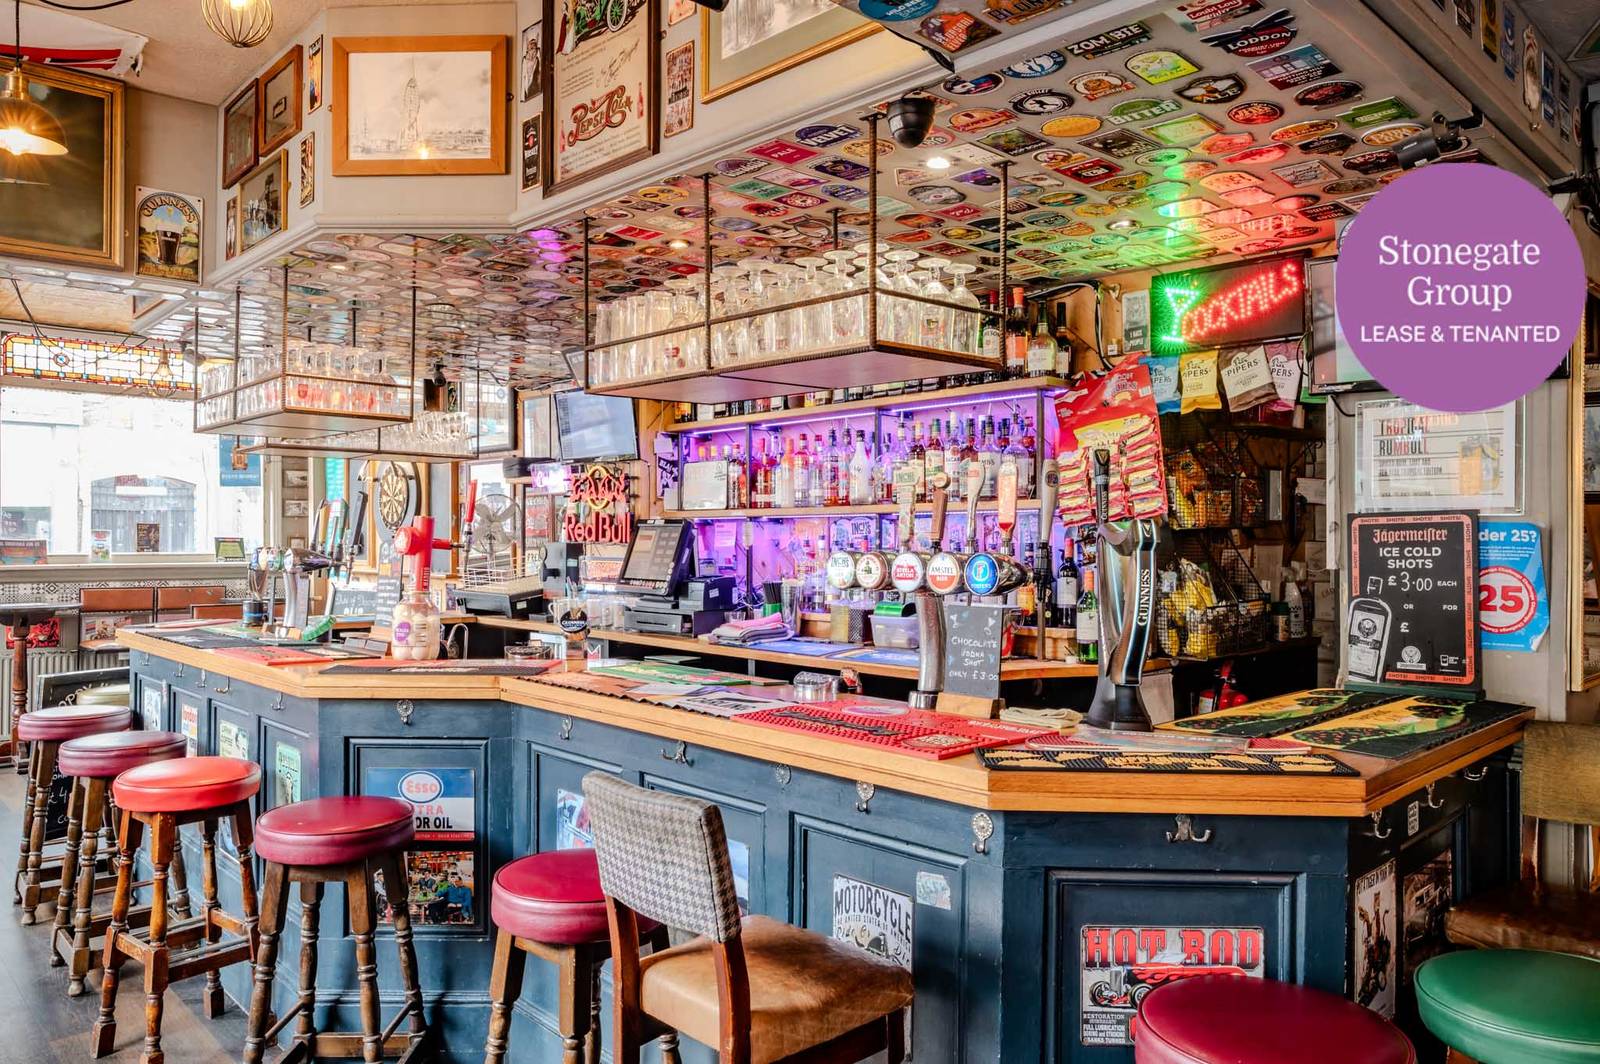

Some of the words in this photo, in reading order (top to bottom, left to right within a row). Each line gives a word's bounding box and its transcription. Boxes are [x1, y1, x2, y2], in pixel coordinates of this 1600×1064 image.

[1228, 31, 1293, 51] LODDON
[1107, 101, 1180, 125] BITTER
[801, 126, 856, 147] VELVET
[771, 147, 797, 159] PALE
[143, 196, 197, 223] GUINNESS
[1181, 262, 1299, 341] COCKTAILS
[1226, 359, 1260, 377] PIPERS
[565, 512, 596, 543] Red
[599, 512, 631, 543] Bull
[1478, 529, 1506, 542] der
[1511, 530, 1537, 543] 25?
[1379, 547, 1400, 557] ICE
[1404, 547, 1442, 557] COLD
[931, 567, 953, 575] AMSTEL
[1387, 559, 1433, 569] SHOTS
[1137, 568, 1151, 627] GUINNESS
[1480, 584, 1524, 613] 25
[1400, 622, 1410, 633] £
[963, 658, 985, 666] SHOT
[417, 804, 444, 815] TRA
[433, 816, 453, 829] OIL
[834, 885, 911, 943] MOTORCYCLE
[1086, 928, 1166, 968] HOT
[1181, 929, 1261, 969] ROD
